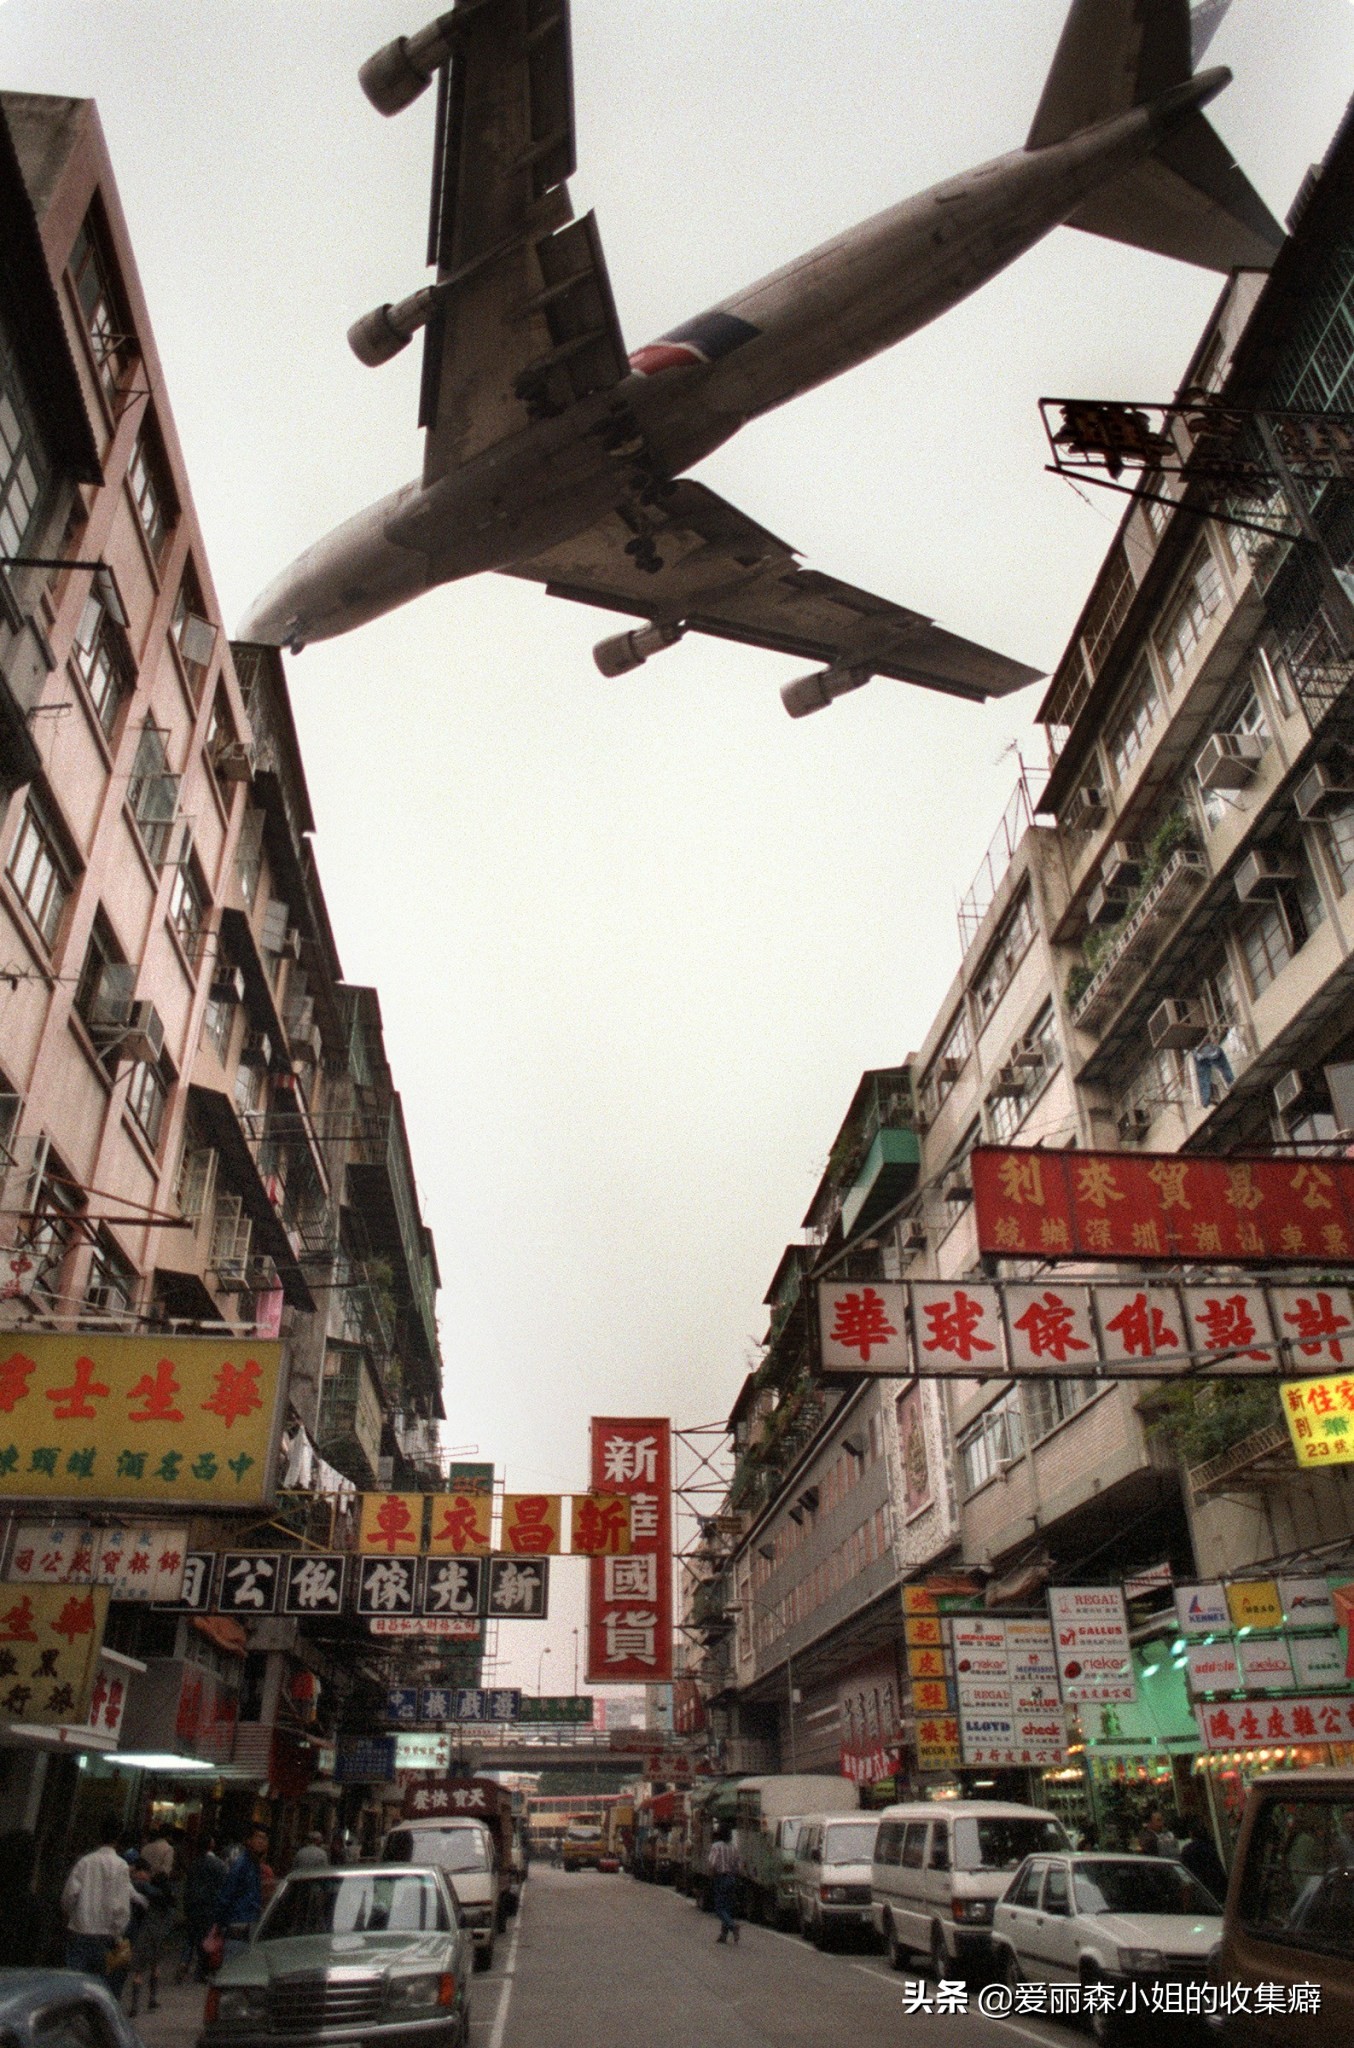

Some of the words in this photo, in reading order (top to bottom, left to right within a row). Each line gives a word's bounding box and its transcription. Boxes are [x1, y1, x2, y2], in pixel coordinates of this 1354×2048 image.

[1075, 1594, 1118, 1605] REGAL
[1078, 1626, 1122, 1635] GALLUS
[1083, 1656, 1127, 1669] rieker
[965, 1721, 1011, 1731] LLOYD
[1021, 1722, 1060, 1735] check
